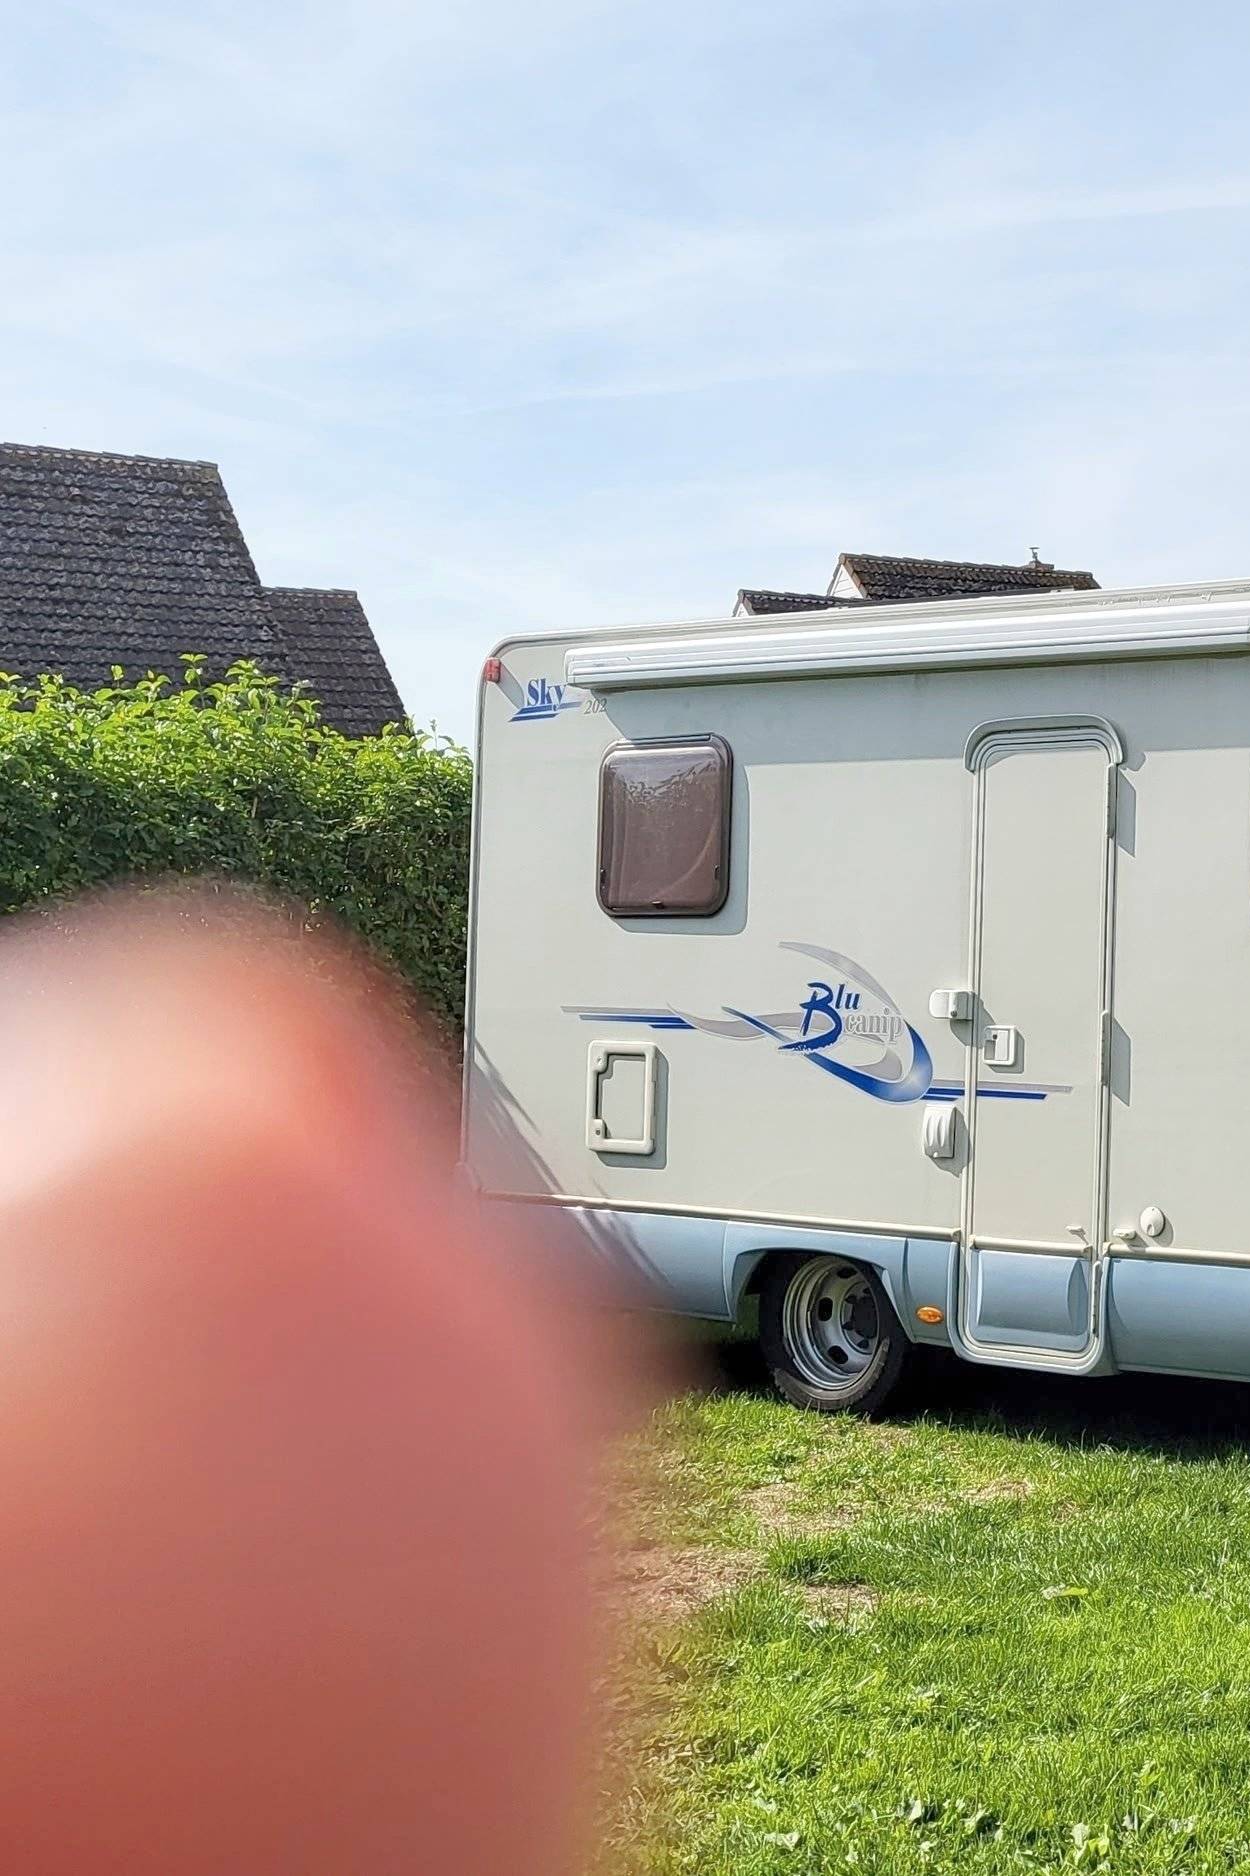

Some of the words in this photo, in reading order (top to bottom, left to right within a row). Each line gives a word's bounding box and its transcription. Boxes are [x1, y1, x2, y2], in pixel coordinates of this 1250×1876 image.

[526, 678, 567, 711] Sky
[583, 698, 607, 714] 202
[778, 982, 861, 1051] Blu
